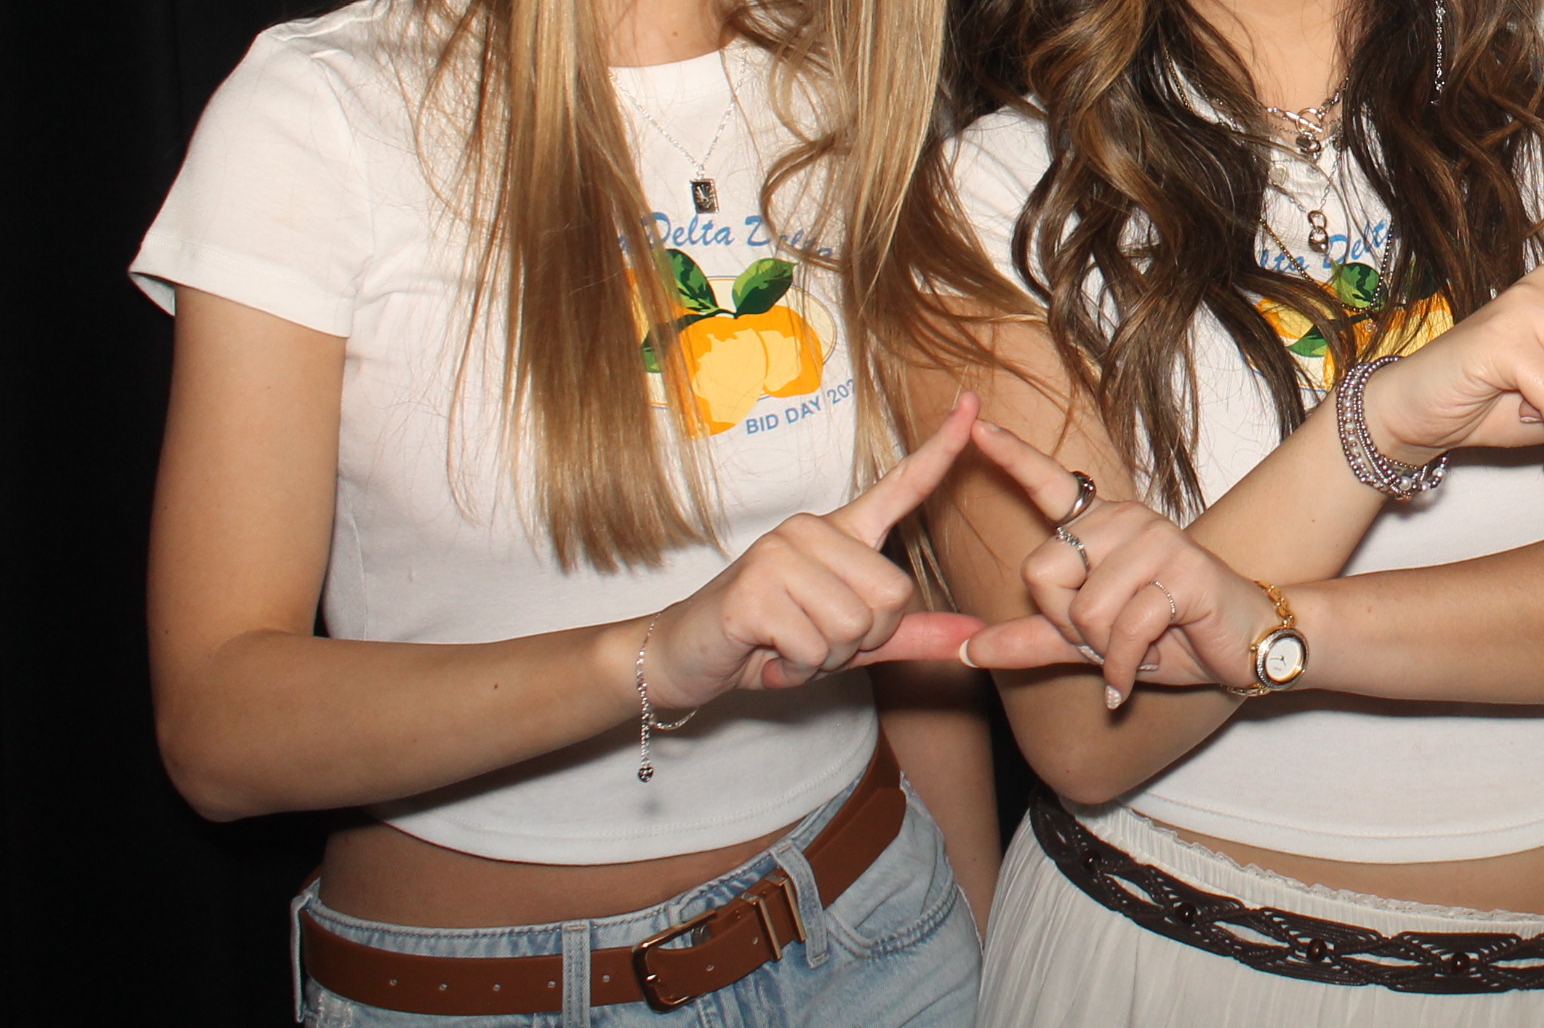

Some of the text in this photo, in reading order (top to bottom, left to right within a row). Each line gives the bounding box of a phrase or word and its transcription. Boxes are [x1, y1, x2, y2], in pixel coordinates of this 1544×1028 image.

[641, 211, 735, 247] Delta
[1323, 220, 1389, 269] Delt
[746, 378, 855, 435] BID DAY 202
